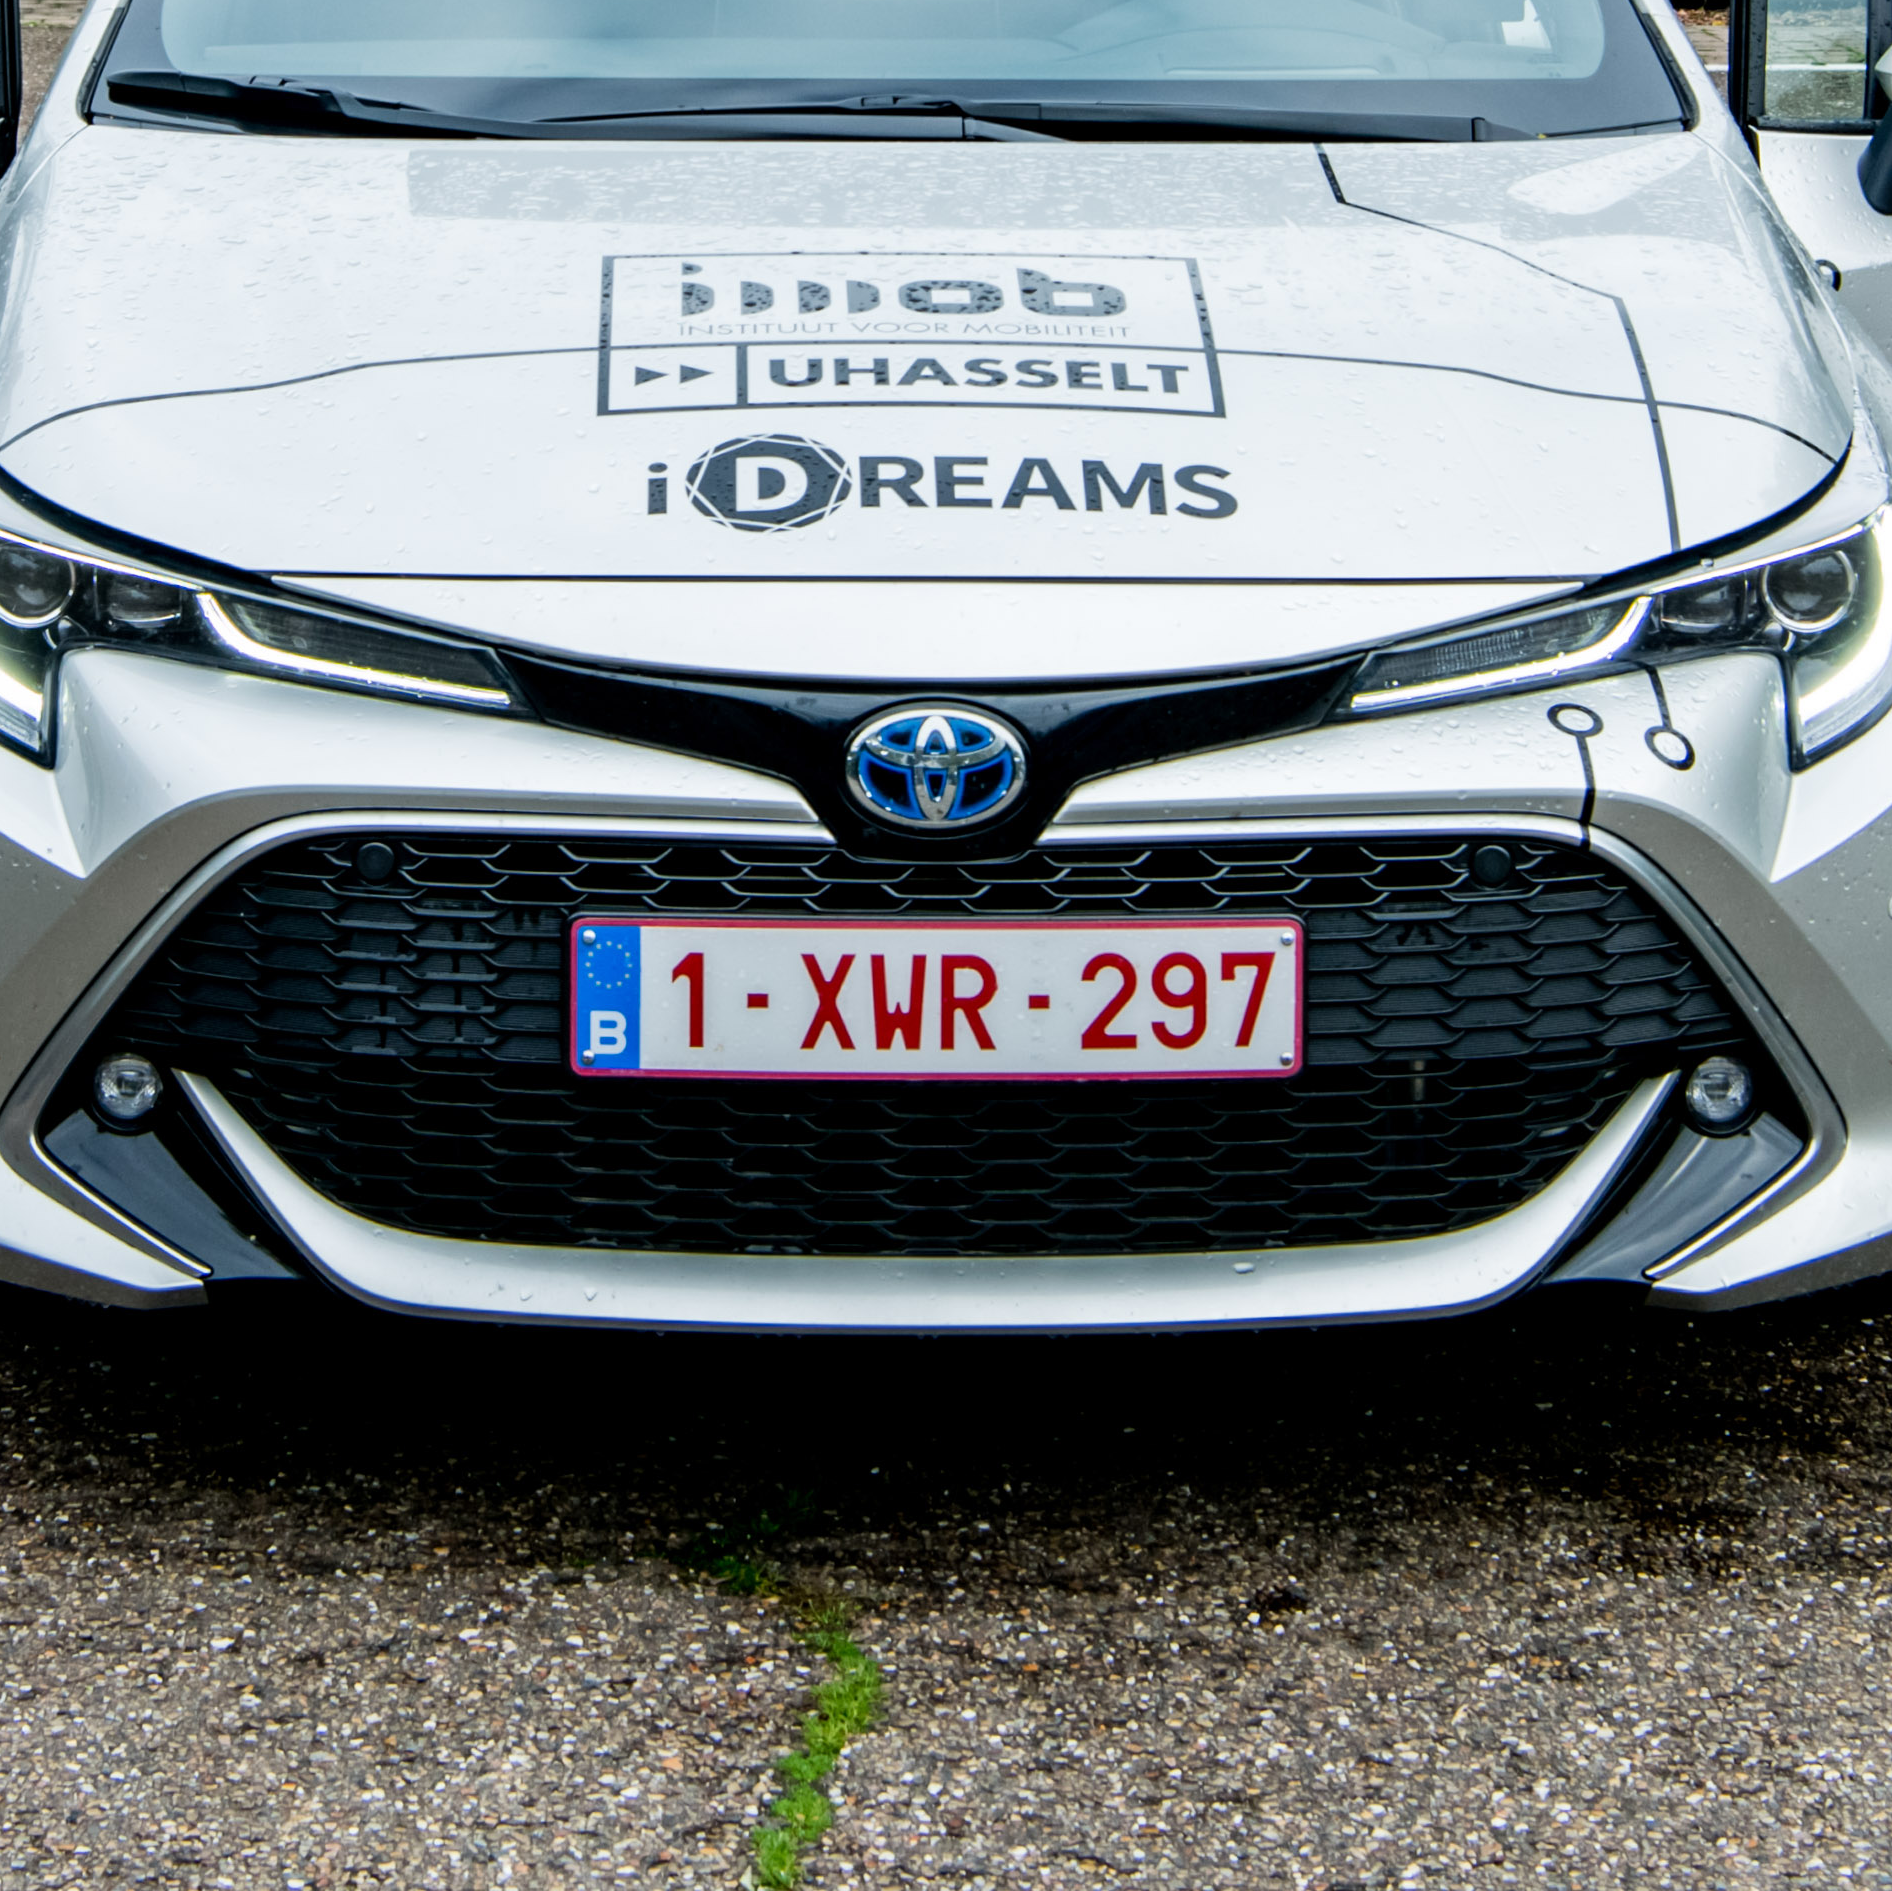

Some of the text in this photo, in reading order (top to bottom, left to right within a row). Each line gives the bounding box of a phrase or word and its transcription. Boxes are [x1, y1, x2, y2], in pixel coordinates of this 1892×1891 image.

[677, 321, 1132, 339] INSTITUUT VOOR MOBILITEIT
[768, 357, 1190, 395] UHASSELT
[589, 1010, 628, 1055] B
